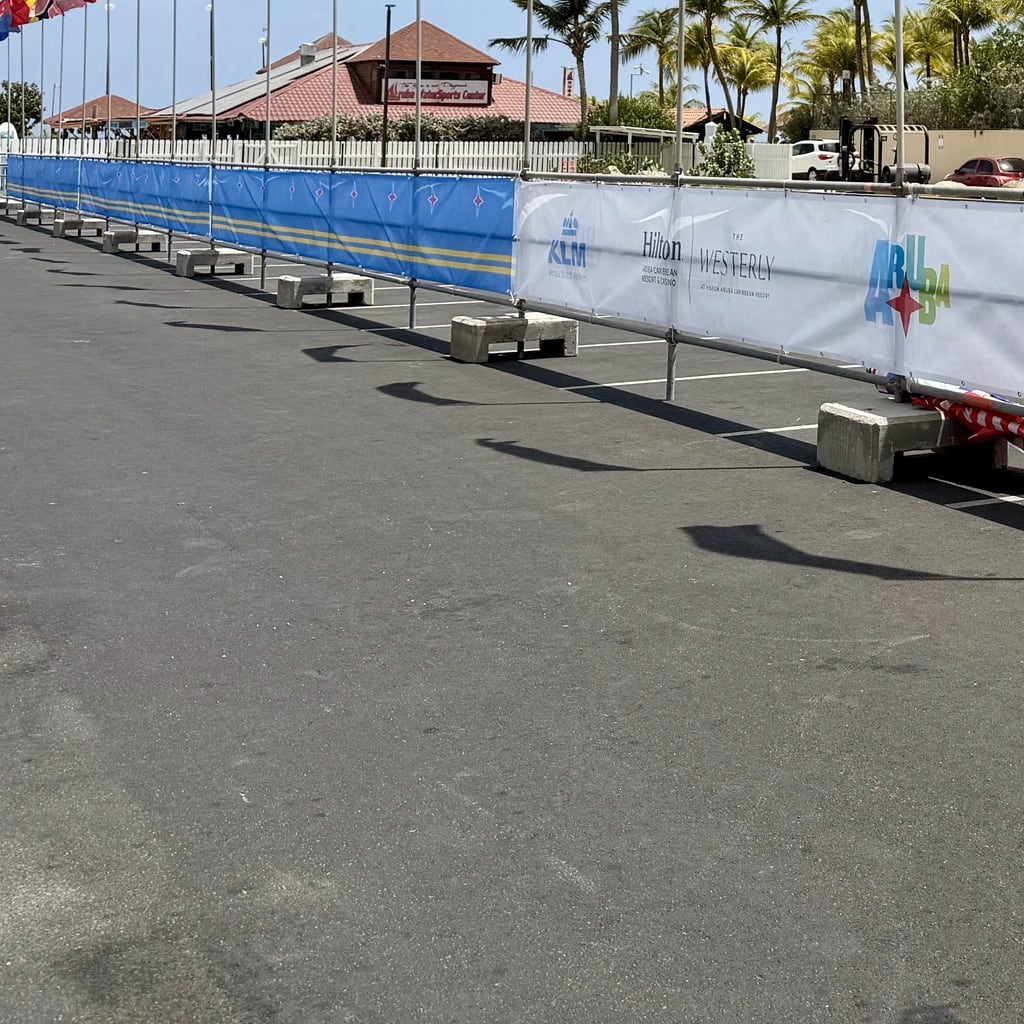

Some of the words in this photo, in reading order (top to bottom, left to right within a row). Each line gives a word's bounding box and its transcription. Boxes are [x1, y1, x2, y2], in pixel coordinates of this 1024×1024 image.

[548, 240, 586, 268] KLM
[643, 232, 681, 261] Hilton
[700, 248, 775, 281] WESTERLY
[864, 234, 951, 326] ARUBA
